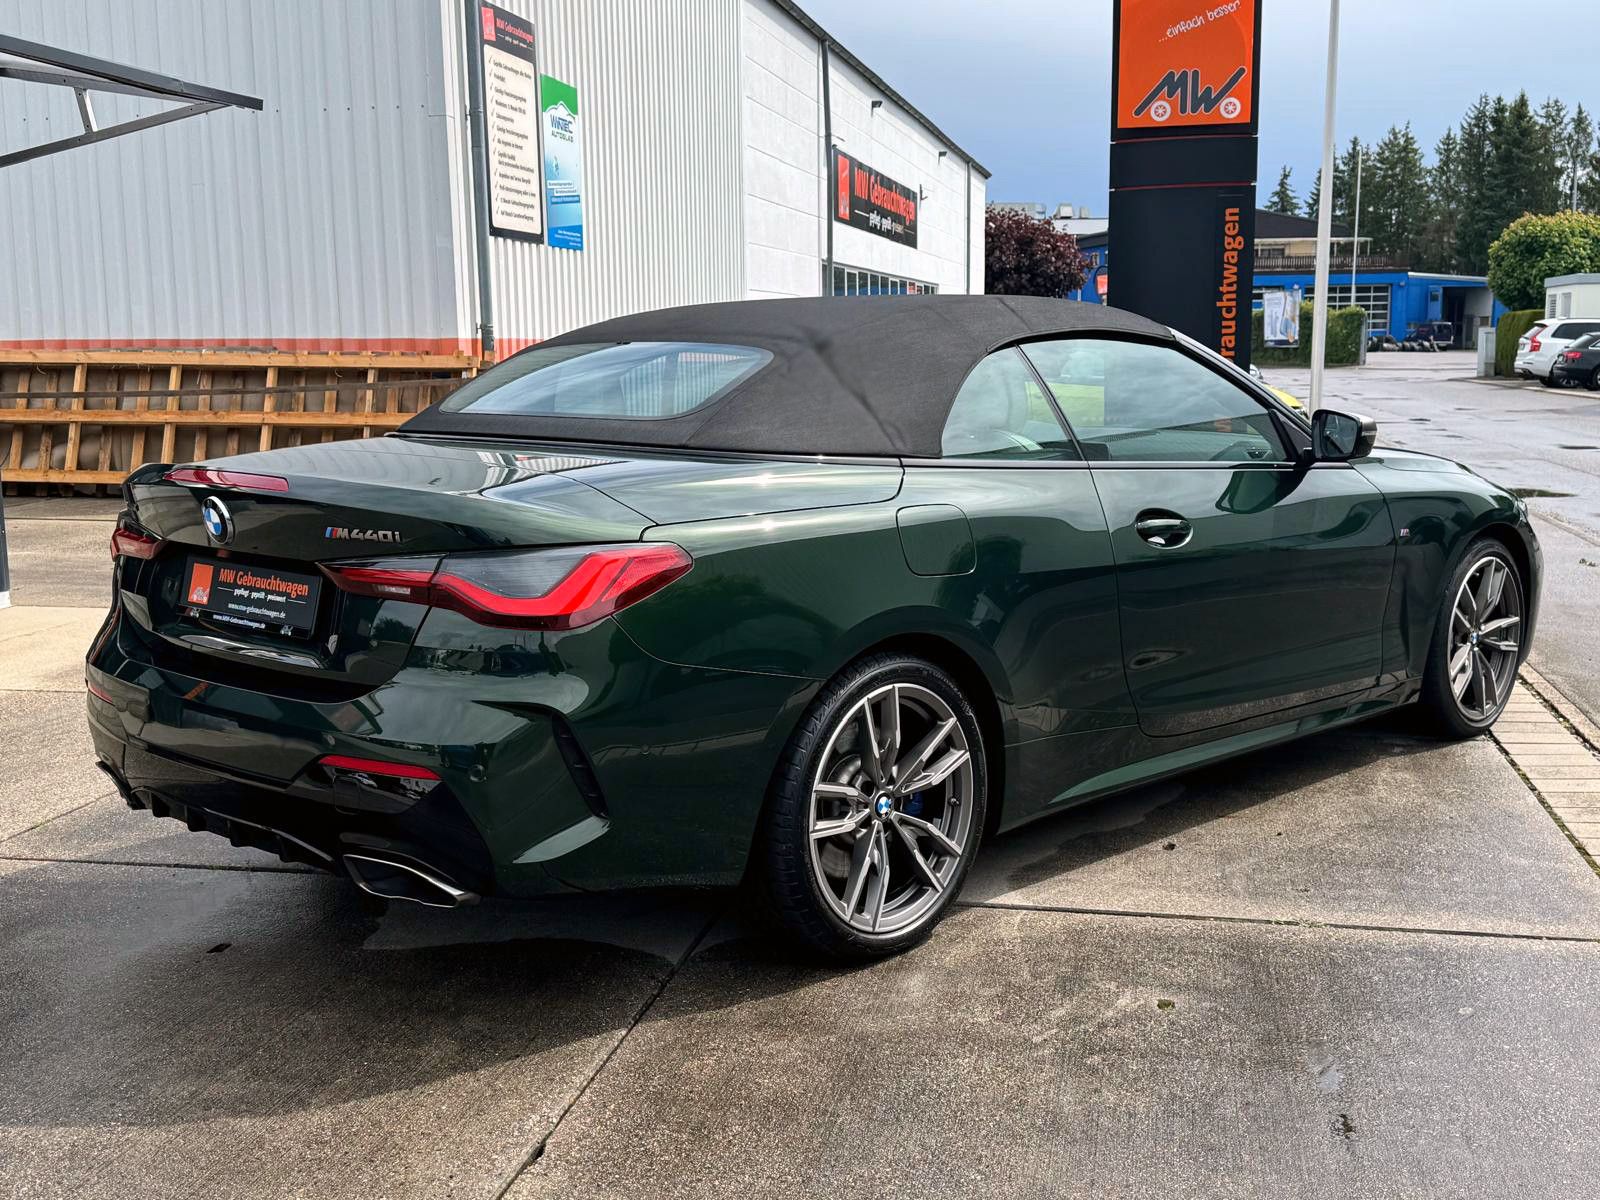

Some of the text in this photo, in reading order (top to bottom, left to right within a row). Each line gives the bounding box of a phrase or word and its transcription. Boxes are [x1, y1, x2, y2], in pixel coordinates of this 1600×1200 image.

[1132, 65, 1247, 118] MW
[854, 166, 869, 201] MW
[869, 175, 916, 226] Gebrauchtwagen
[334, 527, 401, 543] M440i
[218, 567, 309, 599] MW Gebrauchtwagen
